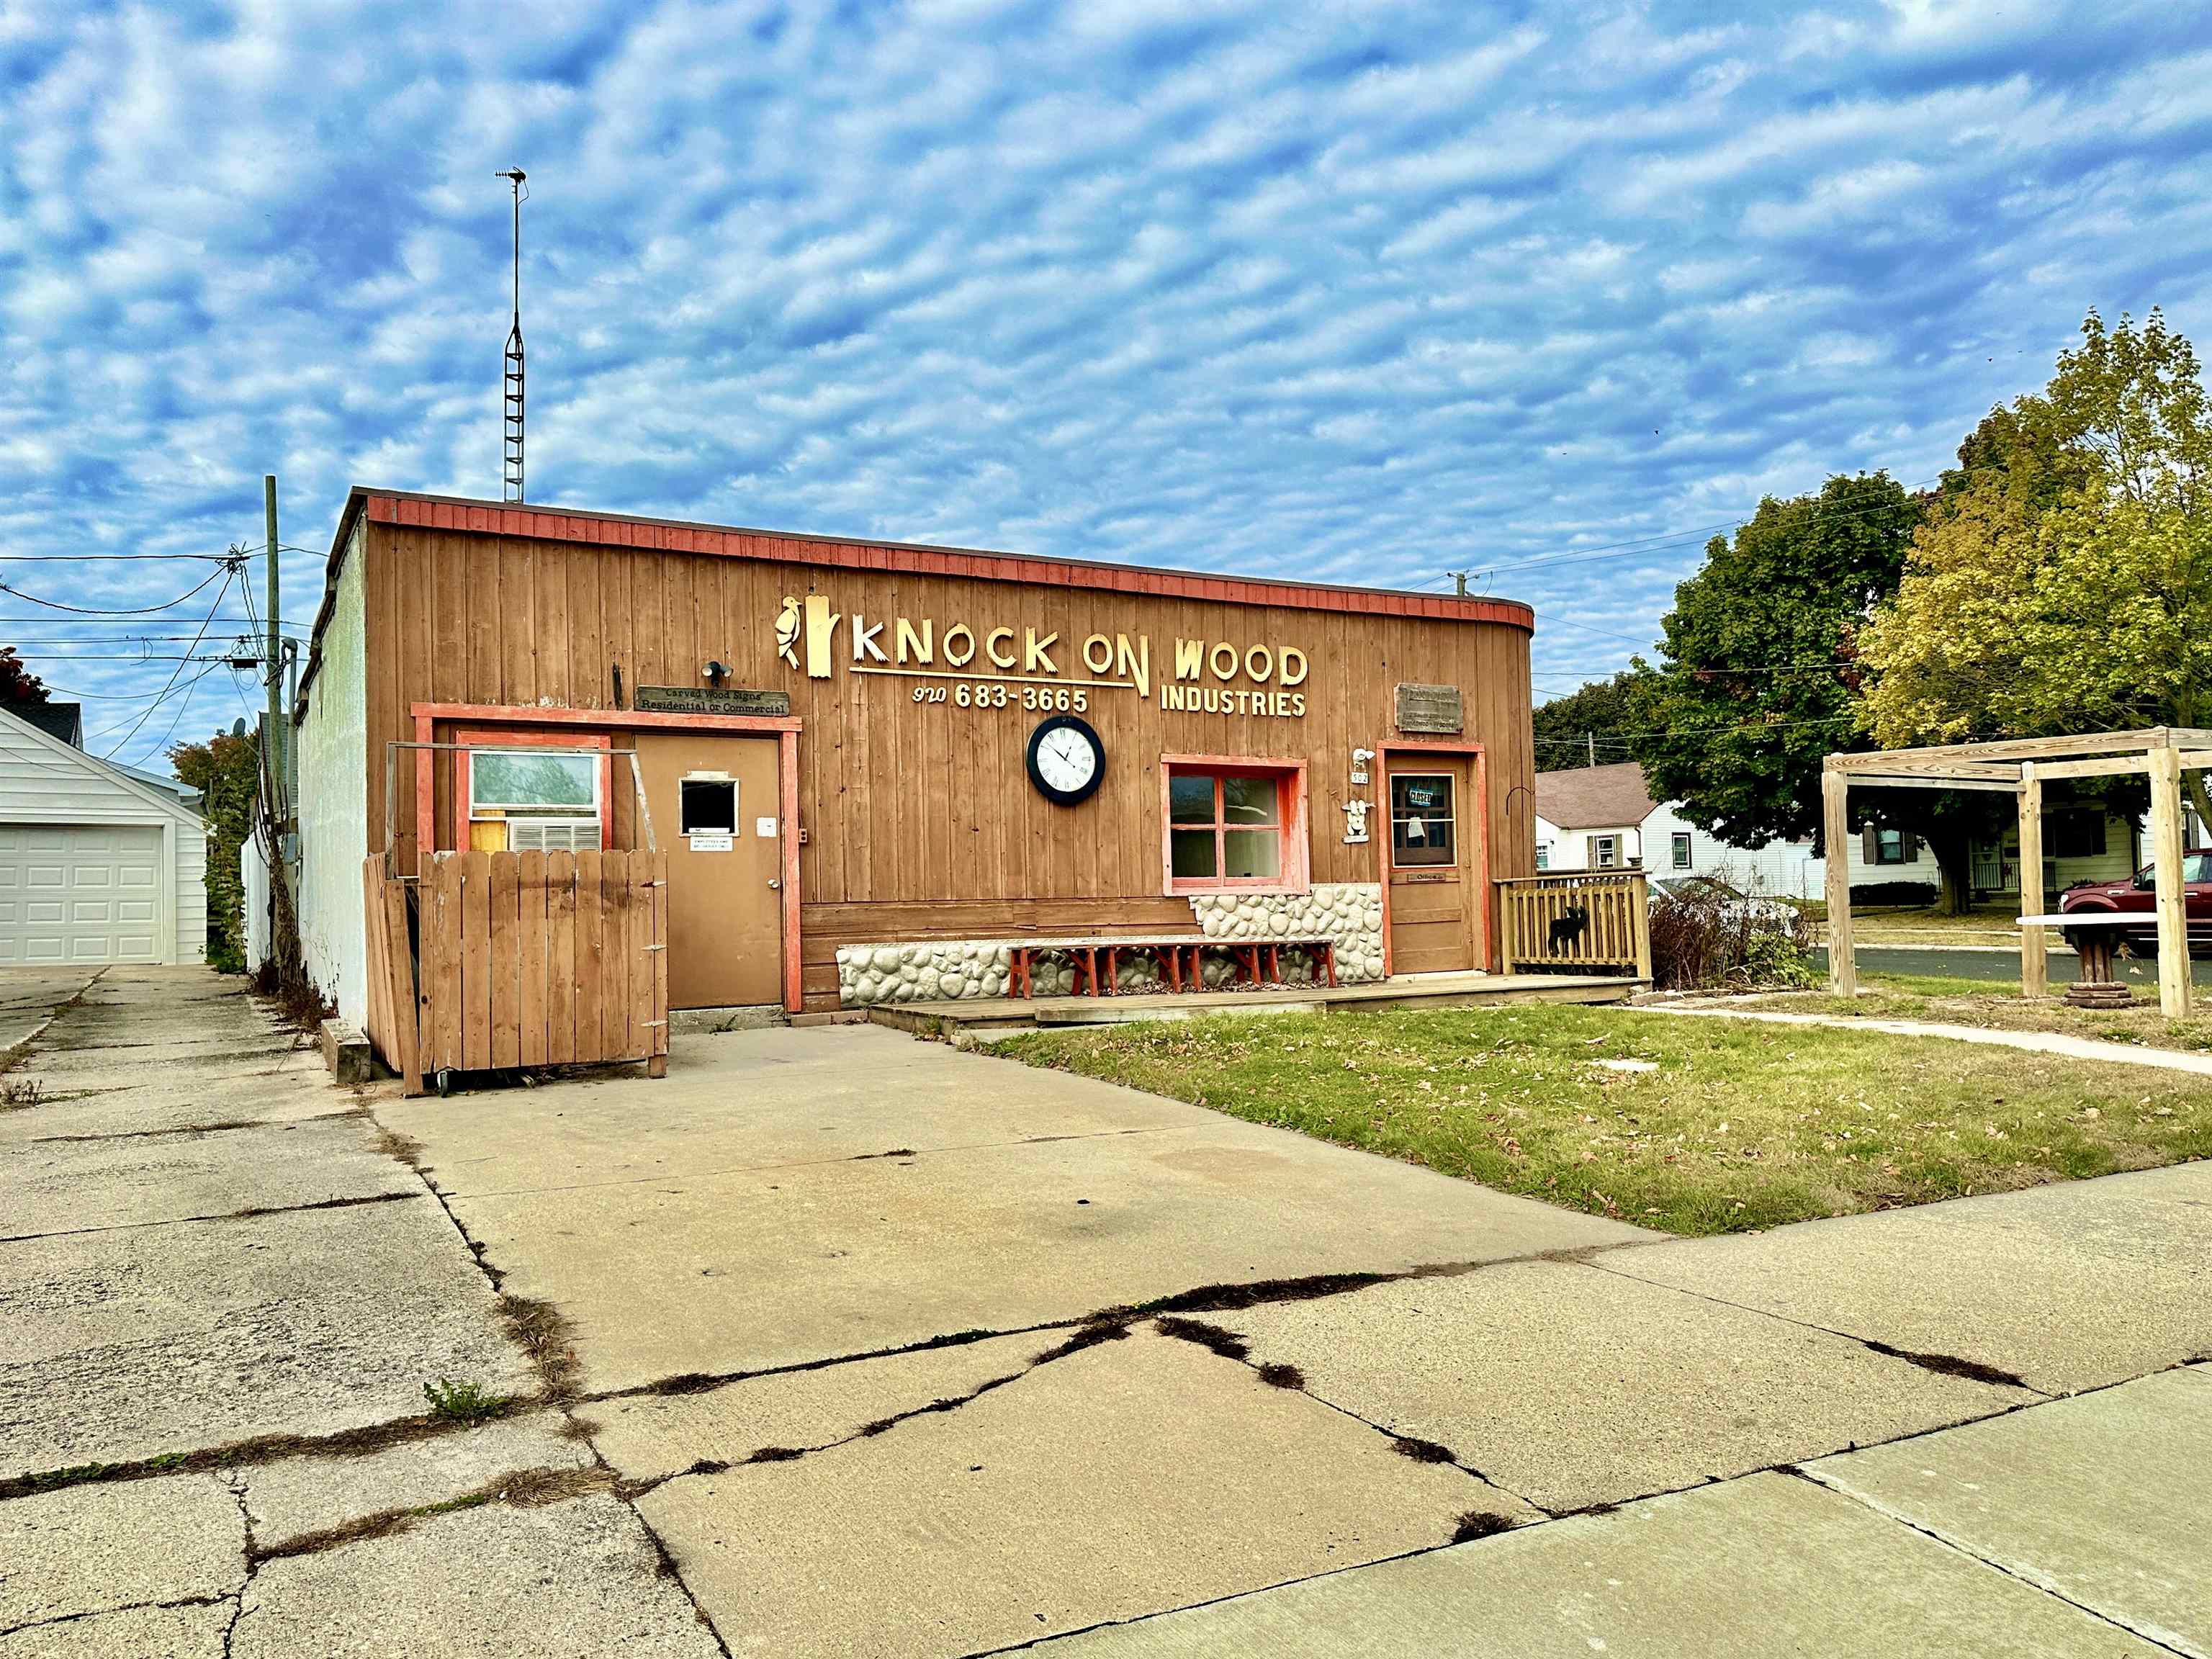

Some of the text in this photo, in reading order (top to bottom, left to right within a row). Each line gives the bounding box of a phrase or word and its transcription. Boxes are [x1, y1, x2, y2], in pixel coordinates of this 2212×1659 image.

[853, 613, 1308, 698] KNOCK ON WOOD
[704, 690, 730, 699] Wood
[912, 684, 1088, 713] 920 683-3665
[1161, 685, 1306, 717] INDUSTRIES
[642, 700, 706, 711] Residential
[723, 703, 785, 714] Commercial
[1353, 773, 1367, 783] 502
[1410, 791, 1433, 802] CLOSED
